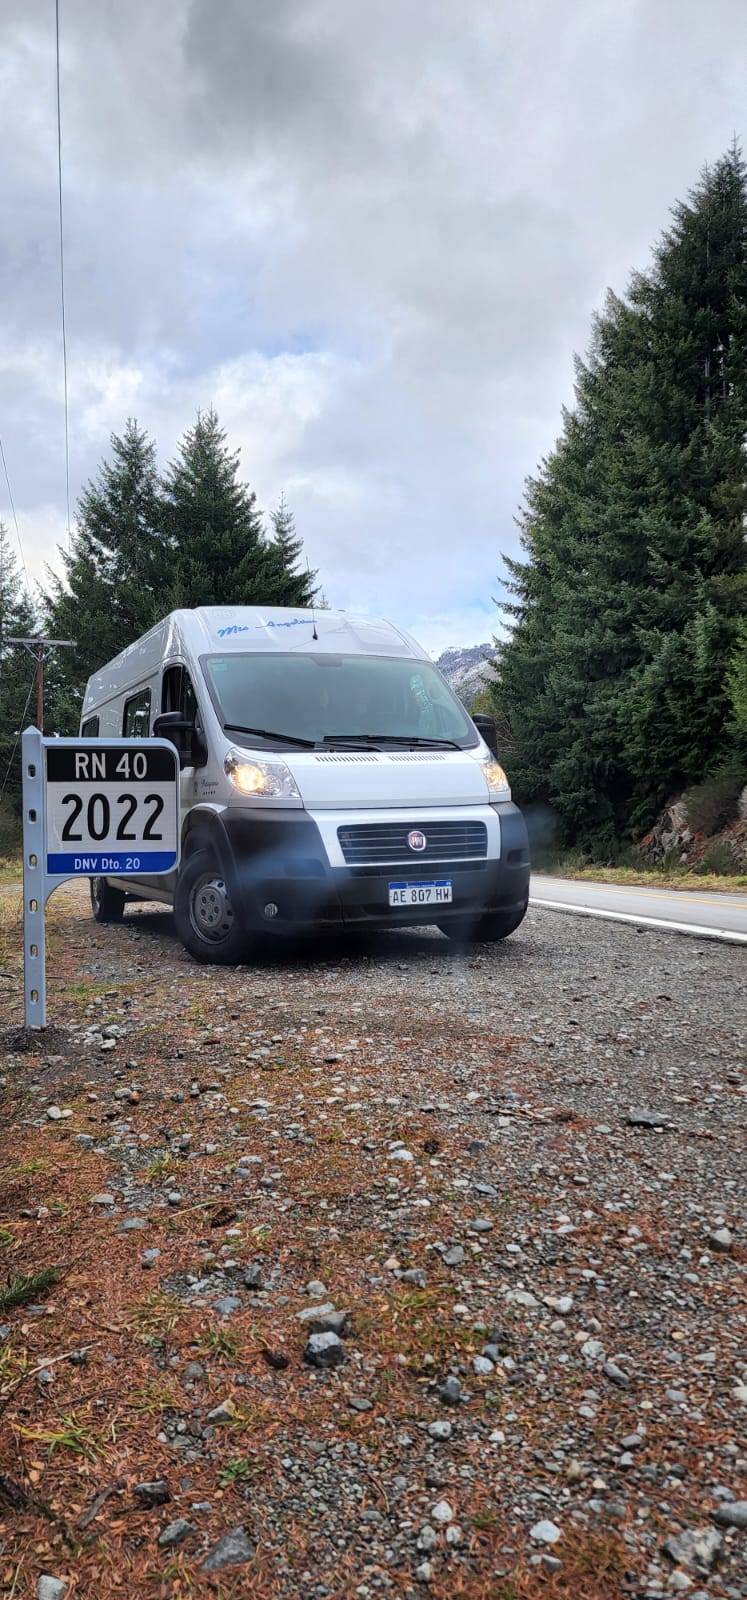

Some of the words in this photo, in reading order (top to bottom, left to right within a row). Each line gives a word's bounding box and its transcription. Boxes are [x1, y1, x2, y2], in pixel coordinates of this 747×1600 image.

[75, 752, 106, 779] RN
[115, 752, 148, 779] 40
[61, 793, 165, 841] 2022
[74, 858, 98, 870] DNV
[101, 858, 122, 870] Dto.
[125, 857, 141, 870] 20
[392, 890, 407, 904] AE
[411, 889, 432, 903] 807
[435, 888, 449, 901] HW
